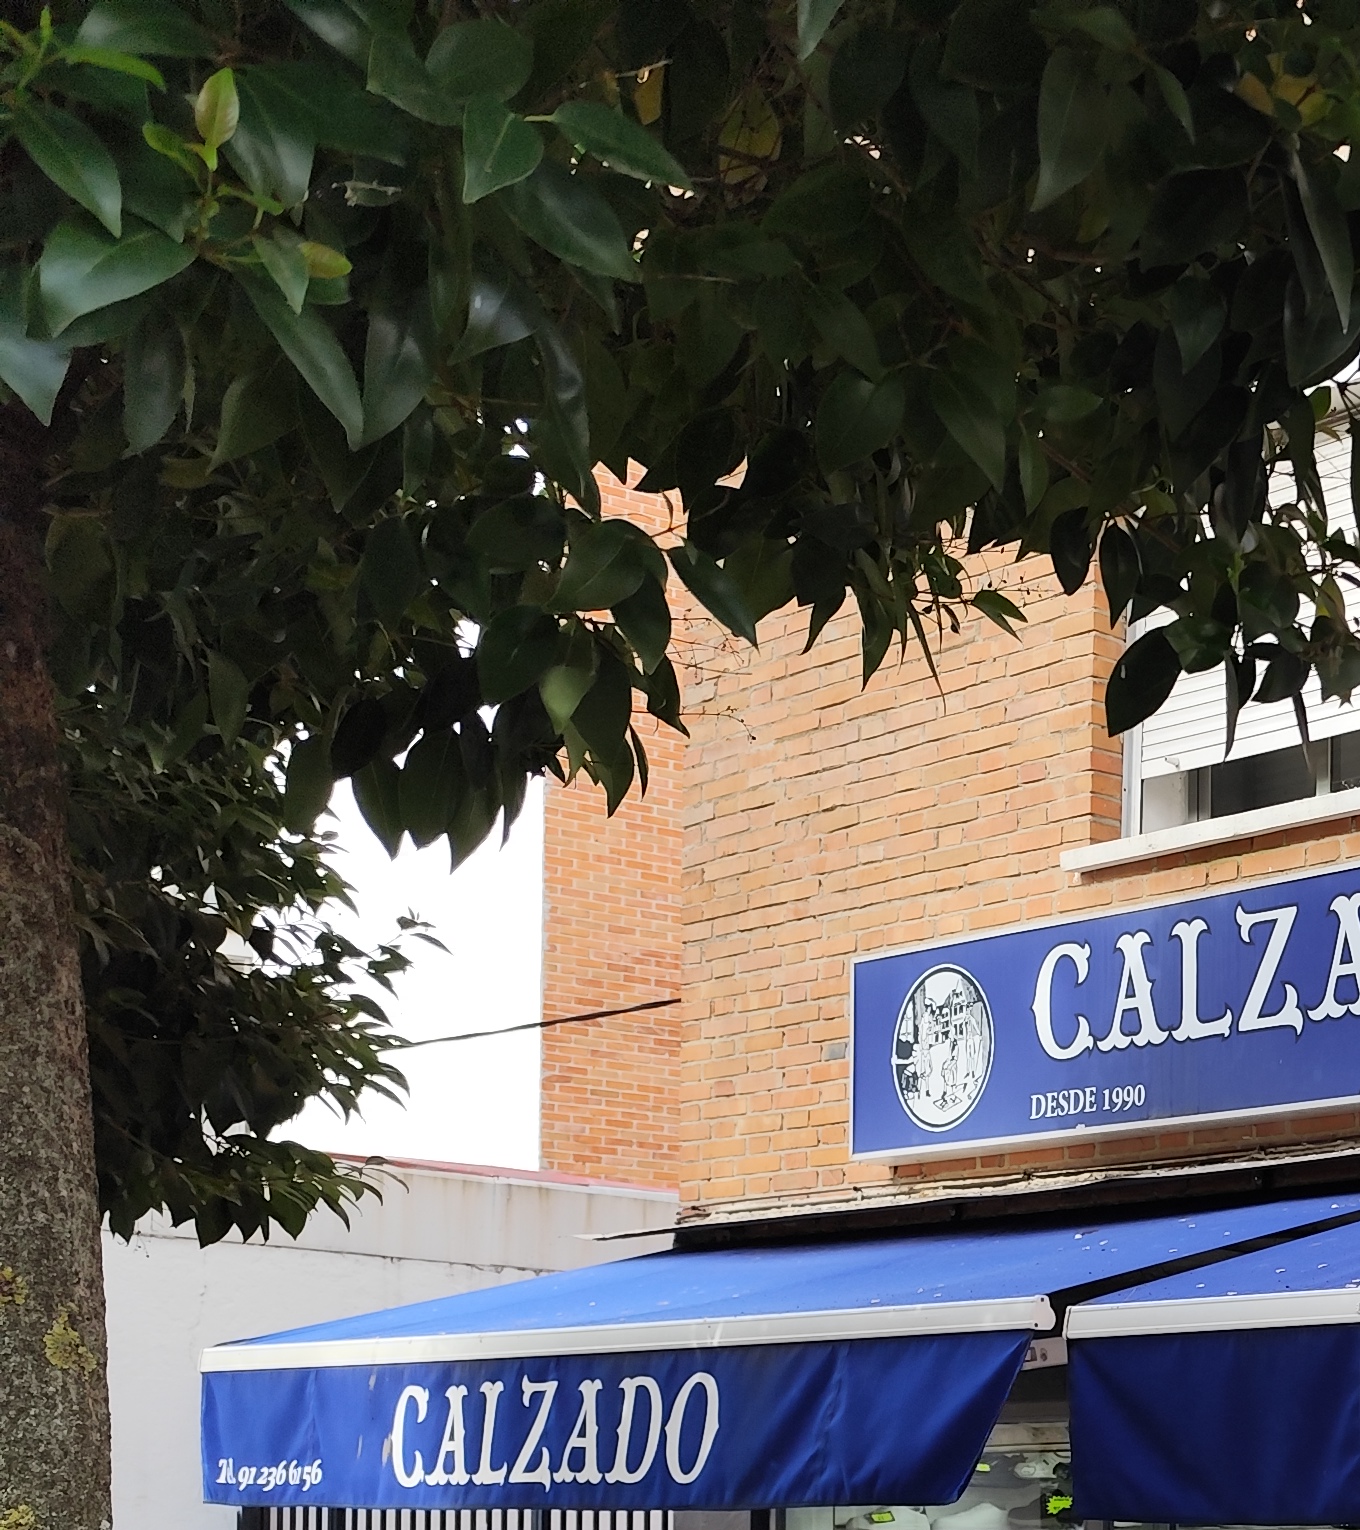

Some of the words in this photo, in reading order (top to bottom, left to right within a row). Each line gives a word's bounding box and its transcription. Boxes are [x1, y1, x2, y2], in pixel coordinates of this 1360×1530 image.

[1030, 1087, 1097, 1119] DESDE
[1103, 1085, 1146, 1112] 1990
[391, 1371, 719, 1491] CALZADO
[256, 1460, 287, 1492] 236
[302, 1458, 323, 1492] 56
